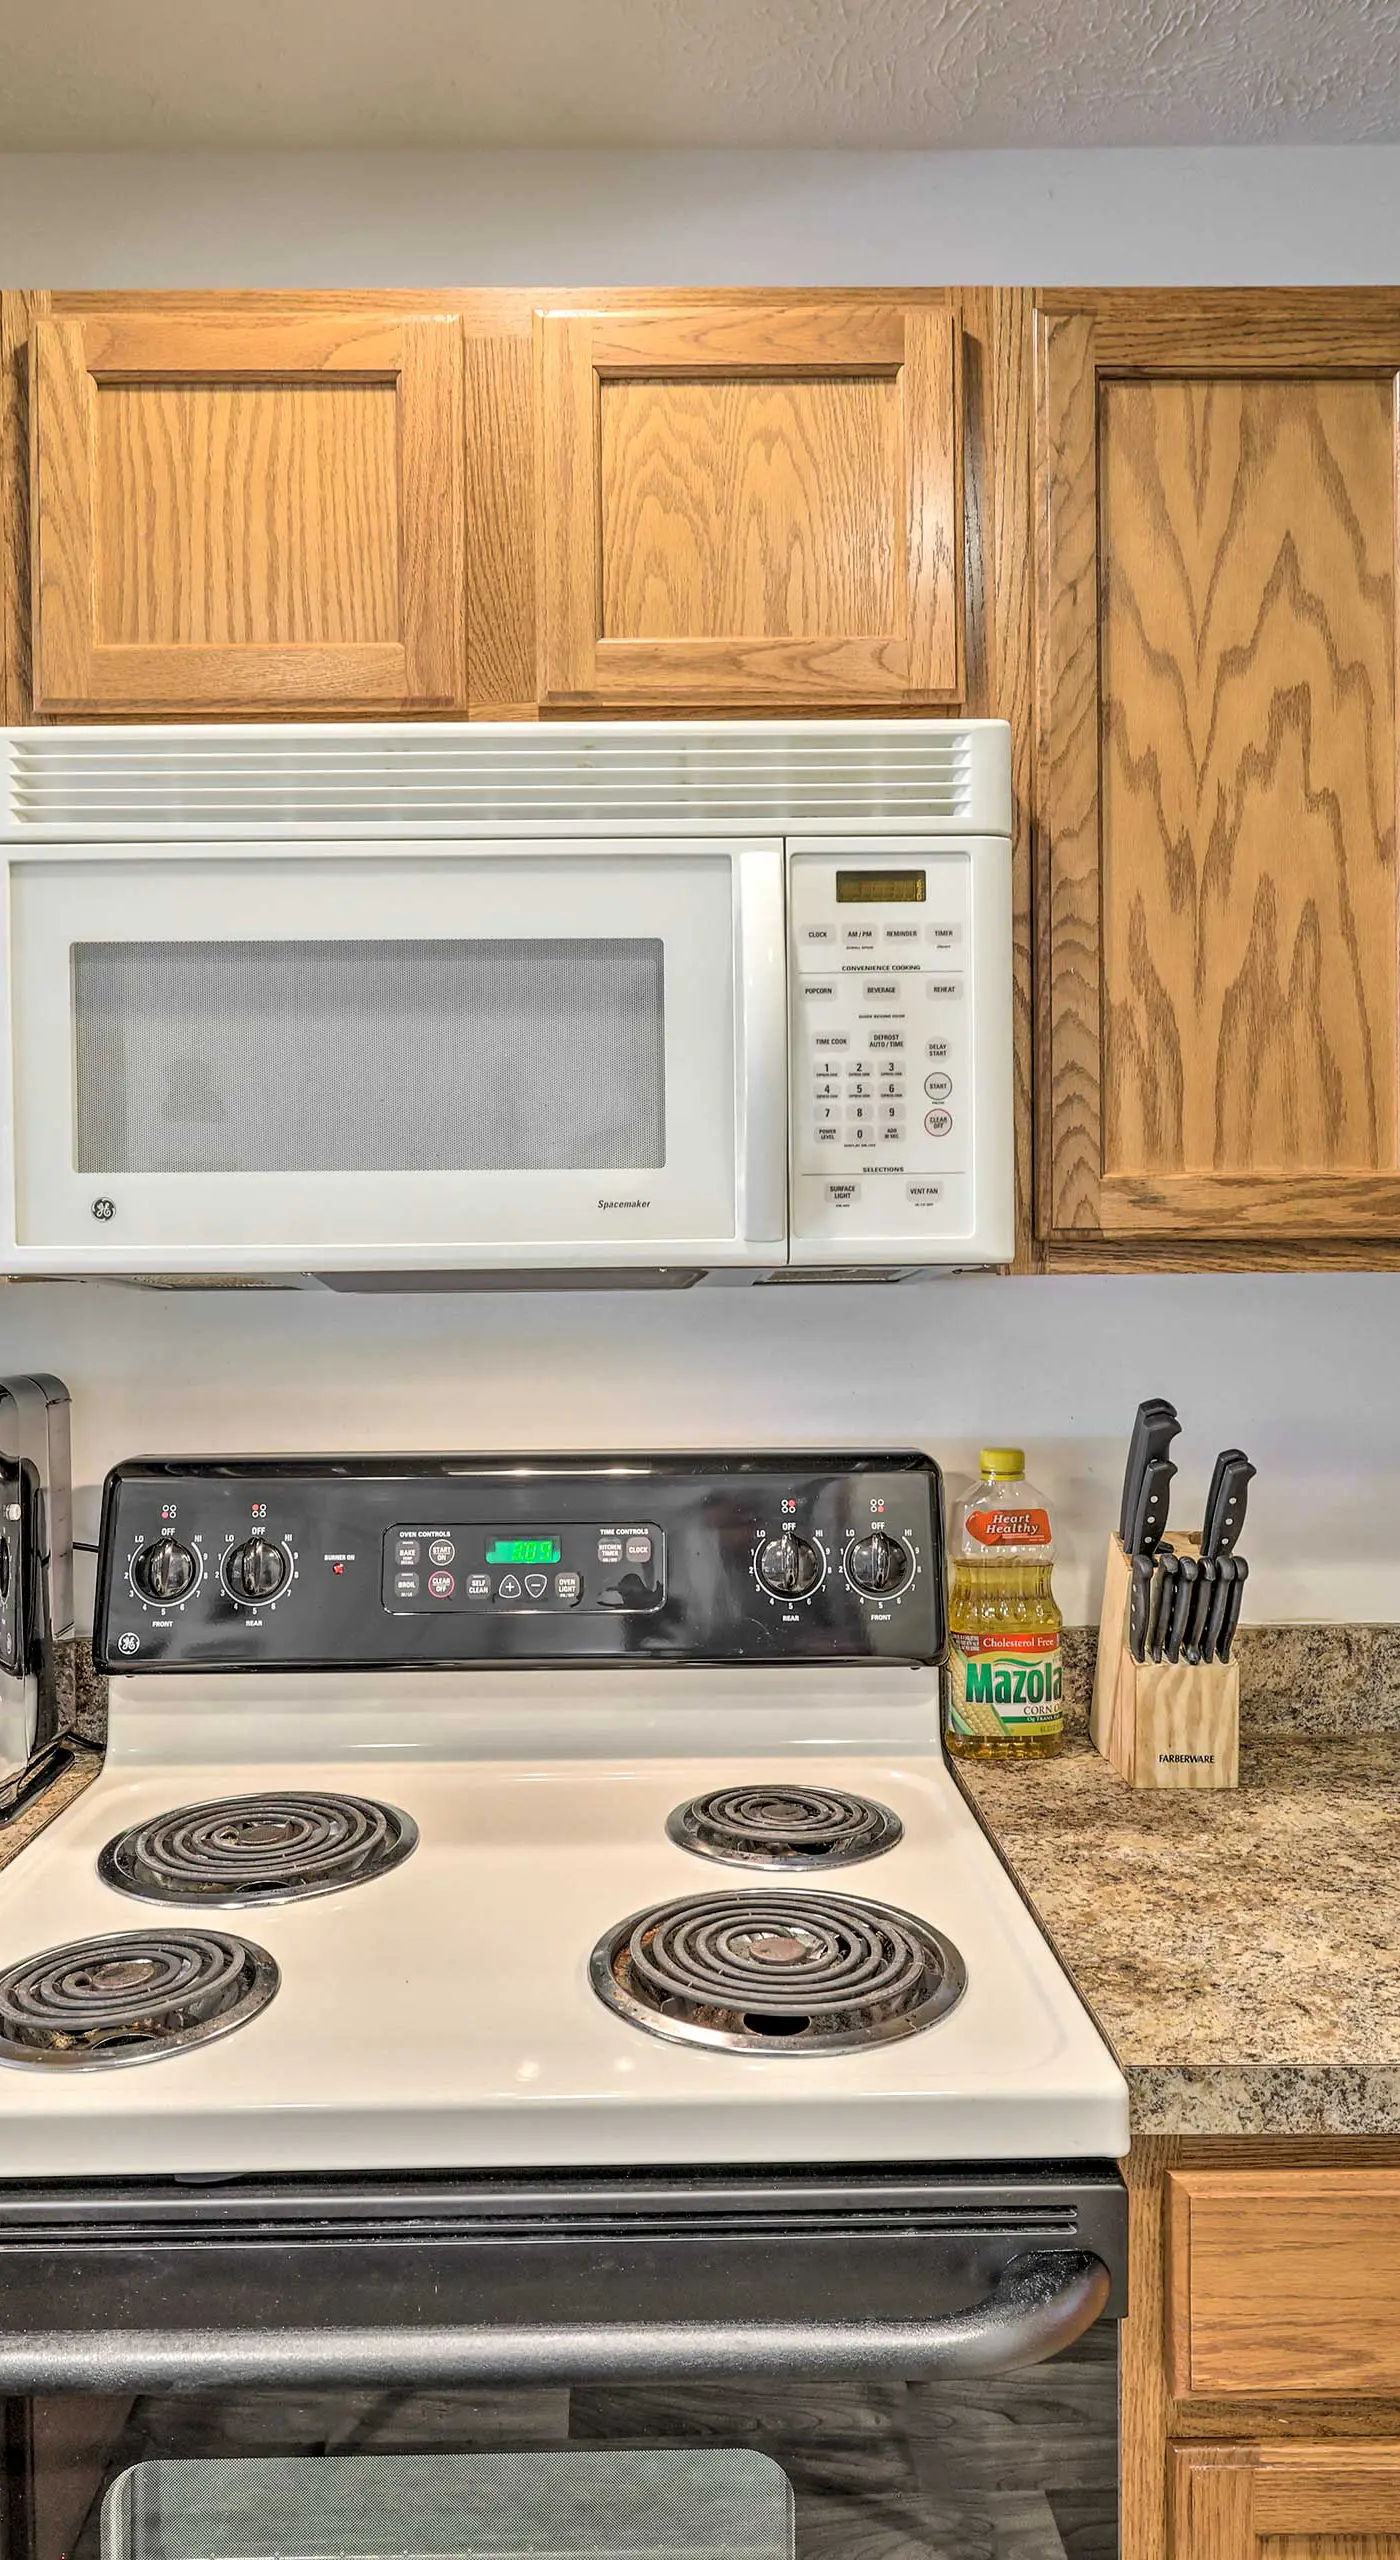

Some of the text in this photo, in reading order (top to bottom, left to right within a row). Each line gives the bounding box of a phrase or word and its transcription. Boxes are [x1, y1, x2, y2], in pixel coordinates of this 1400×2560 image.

[824, 1063, 829, 1073] 1
[856, 1063, 862, 1072] 2
[888, 1062, 894, 1071] 3
[824, 1084, 830, 1094] 4
[856, 1084, 862, 1093] 5
[888, 1084, 894, 1093] 6
[825, 1108, 830, 1117] 7
[857, 1108, 863, 1117] 8
[889, 1107, 895, 1117] 9
[857, 1130, 863, 1139] 0
[597, 1199, 651, 1210] Spacemaker
[993, 1513, 1031, 1524] Heart
[782, 1522, 796, 1531] OFF
[871, 1522, 885, 1530] OFF
[986, 1523, 1039, 1535] Healthy
[161, 1528, 176, 1536] OFF
[251, 1527, 266, 1535] OFF
[845, 1529, 855, 1537] LO
[134, 1535, 144, 1543] LO
[225, 1534, 234, 1542] LO
[432, 1546, 451, 1554] START
[628, 1546, 649, 1554] CLOCK
[432, 1578, 451, 1586] CLEAR
[558, 1578, 576, 1586] OVEN
[436, 1585, 447, 1593] OFF
[468, 1586, 489, 1594] CLEAN
[558, 1585, 576, 1593] LIGHT
[983, 1638, 1035, 1648] Cholesterol
[1037, 1638, 1054, 1646] Free
[965, 1662, 1063, 1704] Mazola
[1023, 1704, 1053, 1716] CORN
[1158, 1754, 1215, 1764] FARBERWARE
